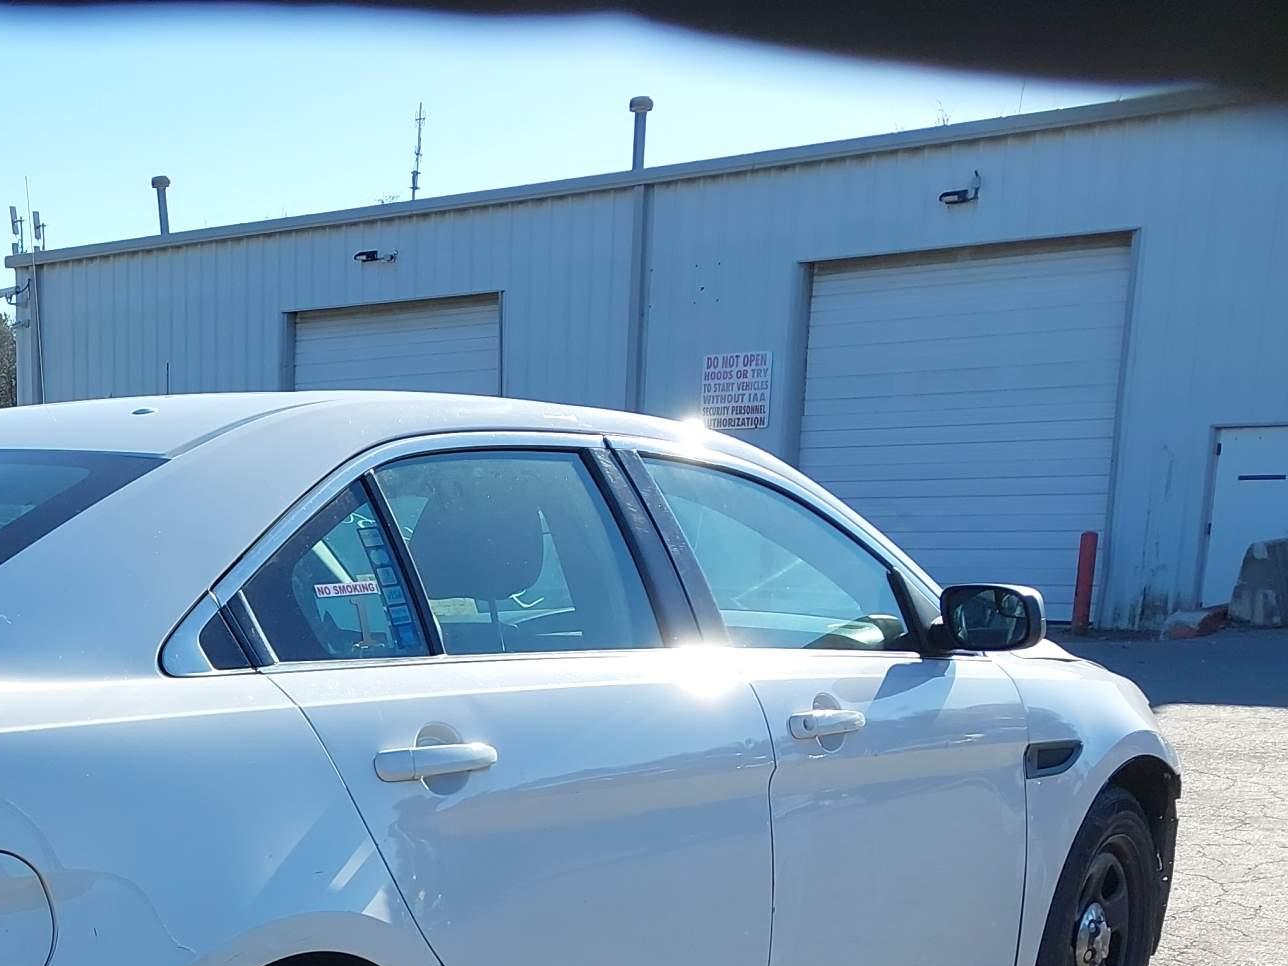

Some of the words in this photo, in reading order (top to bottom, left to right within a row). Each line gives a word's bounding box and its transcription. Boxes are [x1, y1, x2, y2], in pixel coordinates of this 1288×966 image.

[706, 356, 719, 370] DO
[721, 355, 740, 369] NOT
[742, 354, 767, 367] OPEN
[704, 370, 734, 381] HOODS
[736, 369, 748, 379] OR
[751, 368, 769, 379] TRY
[703, 383, 712, 393] TO
[713, 383, 735, 393] START
[736, 380, 769, 392] VEHICLES
[703, 393, 746, 405] WITHOUT
[748, 392, 766, 403] IAA
[702, 406, 730, 416] SECURITY
[731, 405, 766, 415] PERSONNEL
[316, 586, 331, 596] NO
[333, 583, 375, 594] SMOKING
